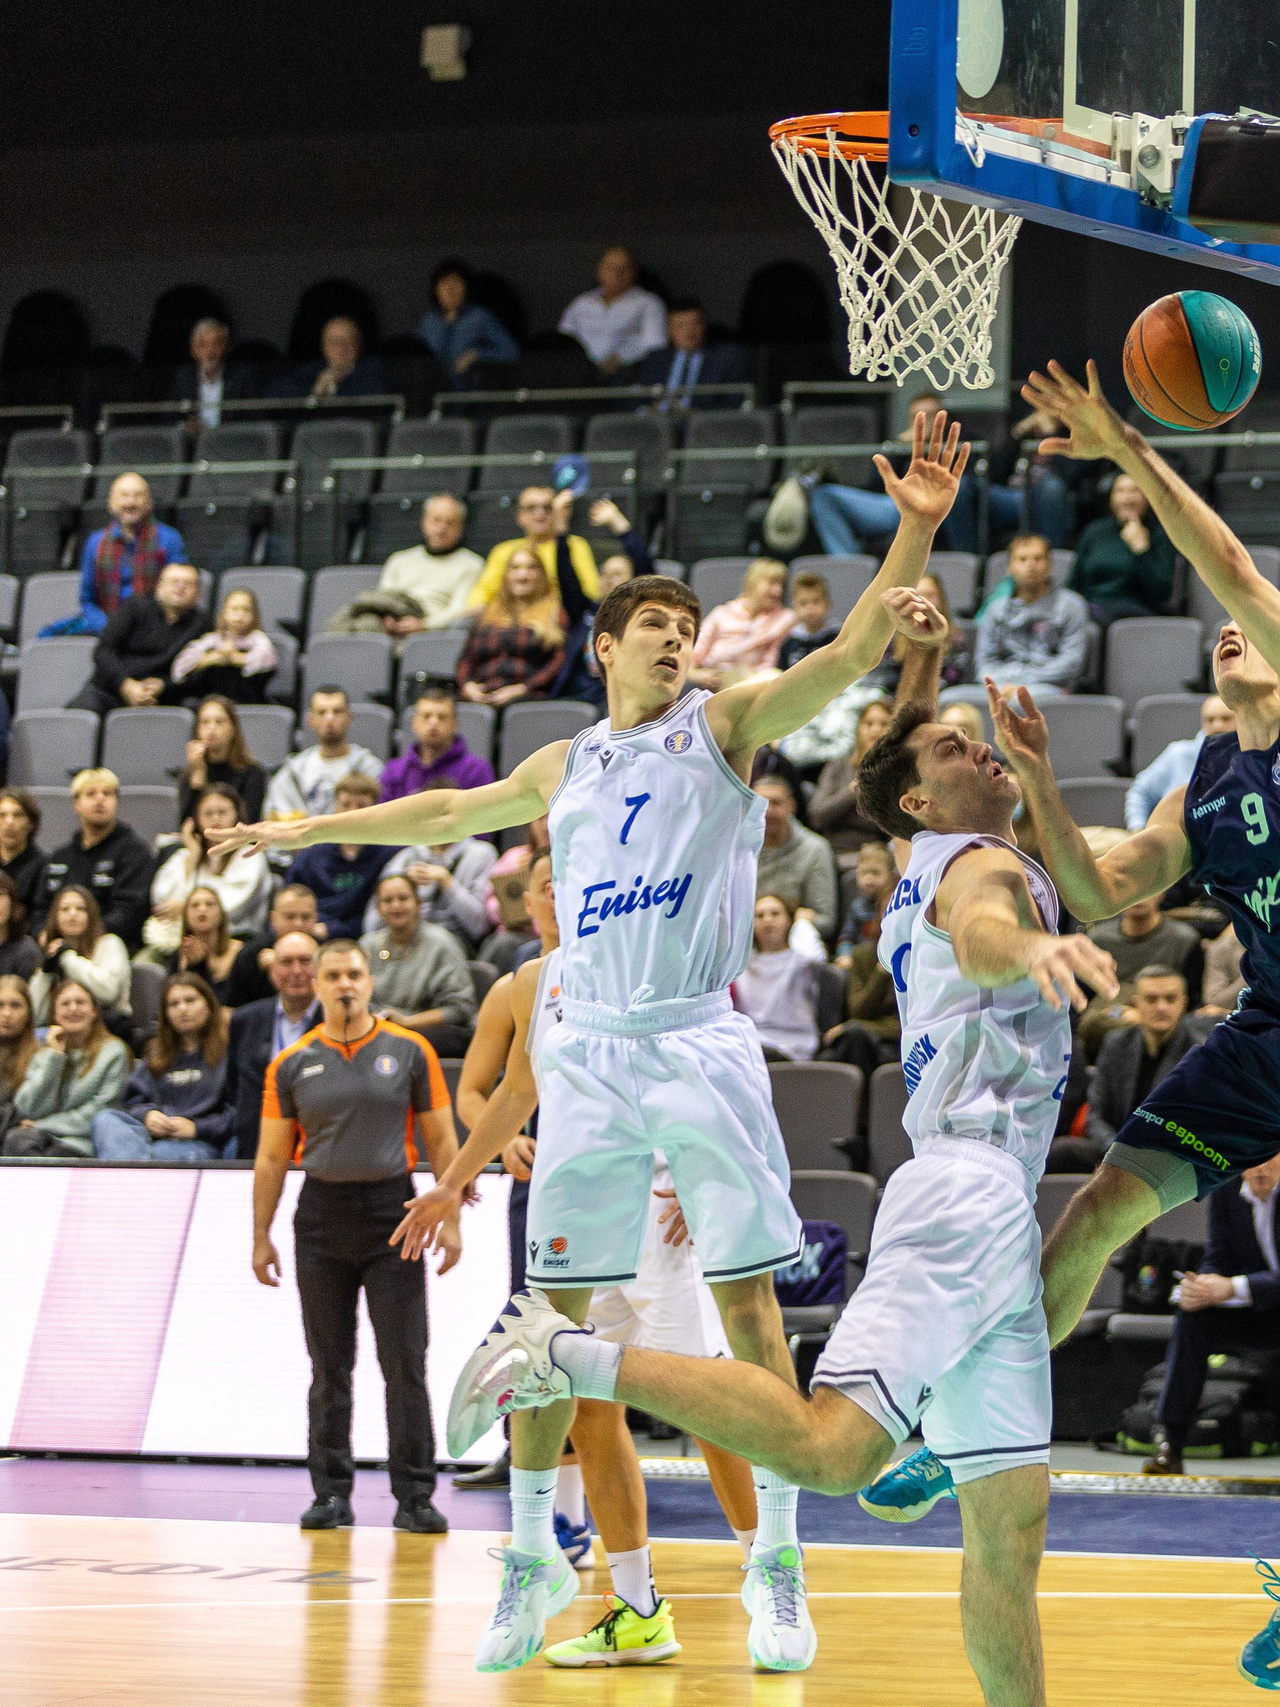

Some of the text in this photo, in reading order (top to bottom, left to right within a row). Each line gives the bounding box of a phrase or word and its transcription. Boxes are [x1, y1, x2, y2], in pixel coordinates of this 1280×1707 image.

[619, 792, 651, 845] 7
[1191, 795, 1227, 820] kempa
[1240, 791, 1270, 846] 9
[577, 872, 694, 939] Enisey
[1132, 1106, 1164, 1126] empa
[1165, 1121, 1231, 1171] евроопт
